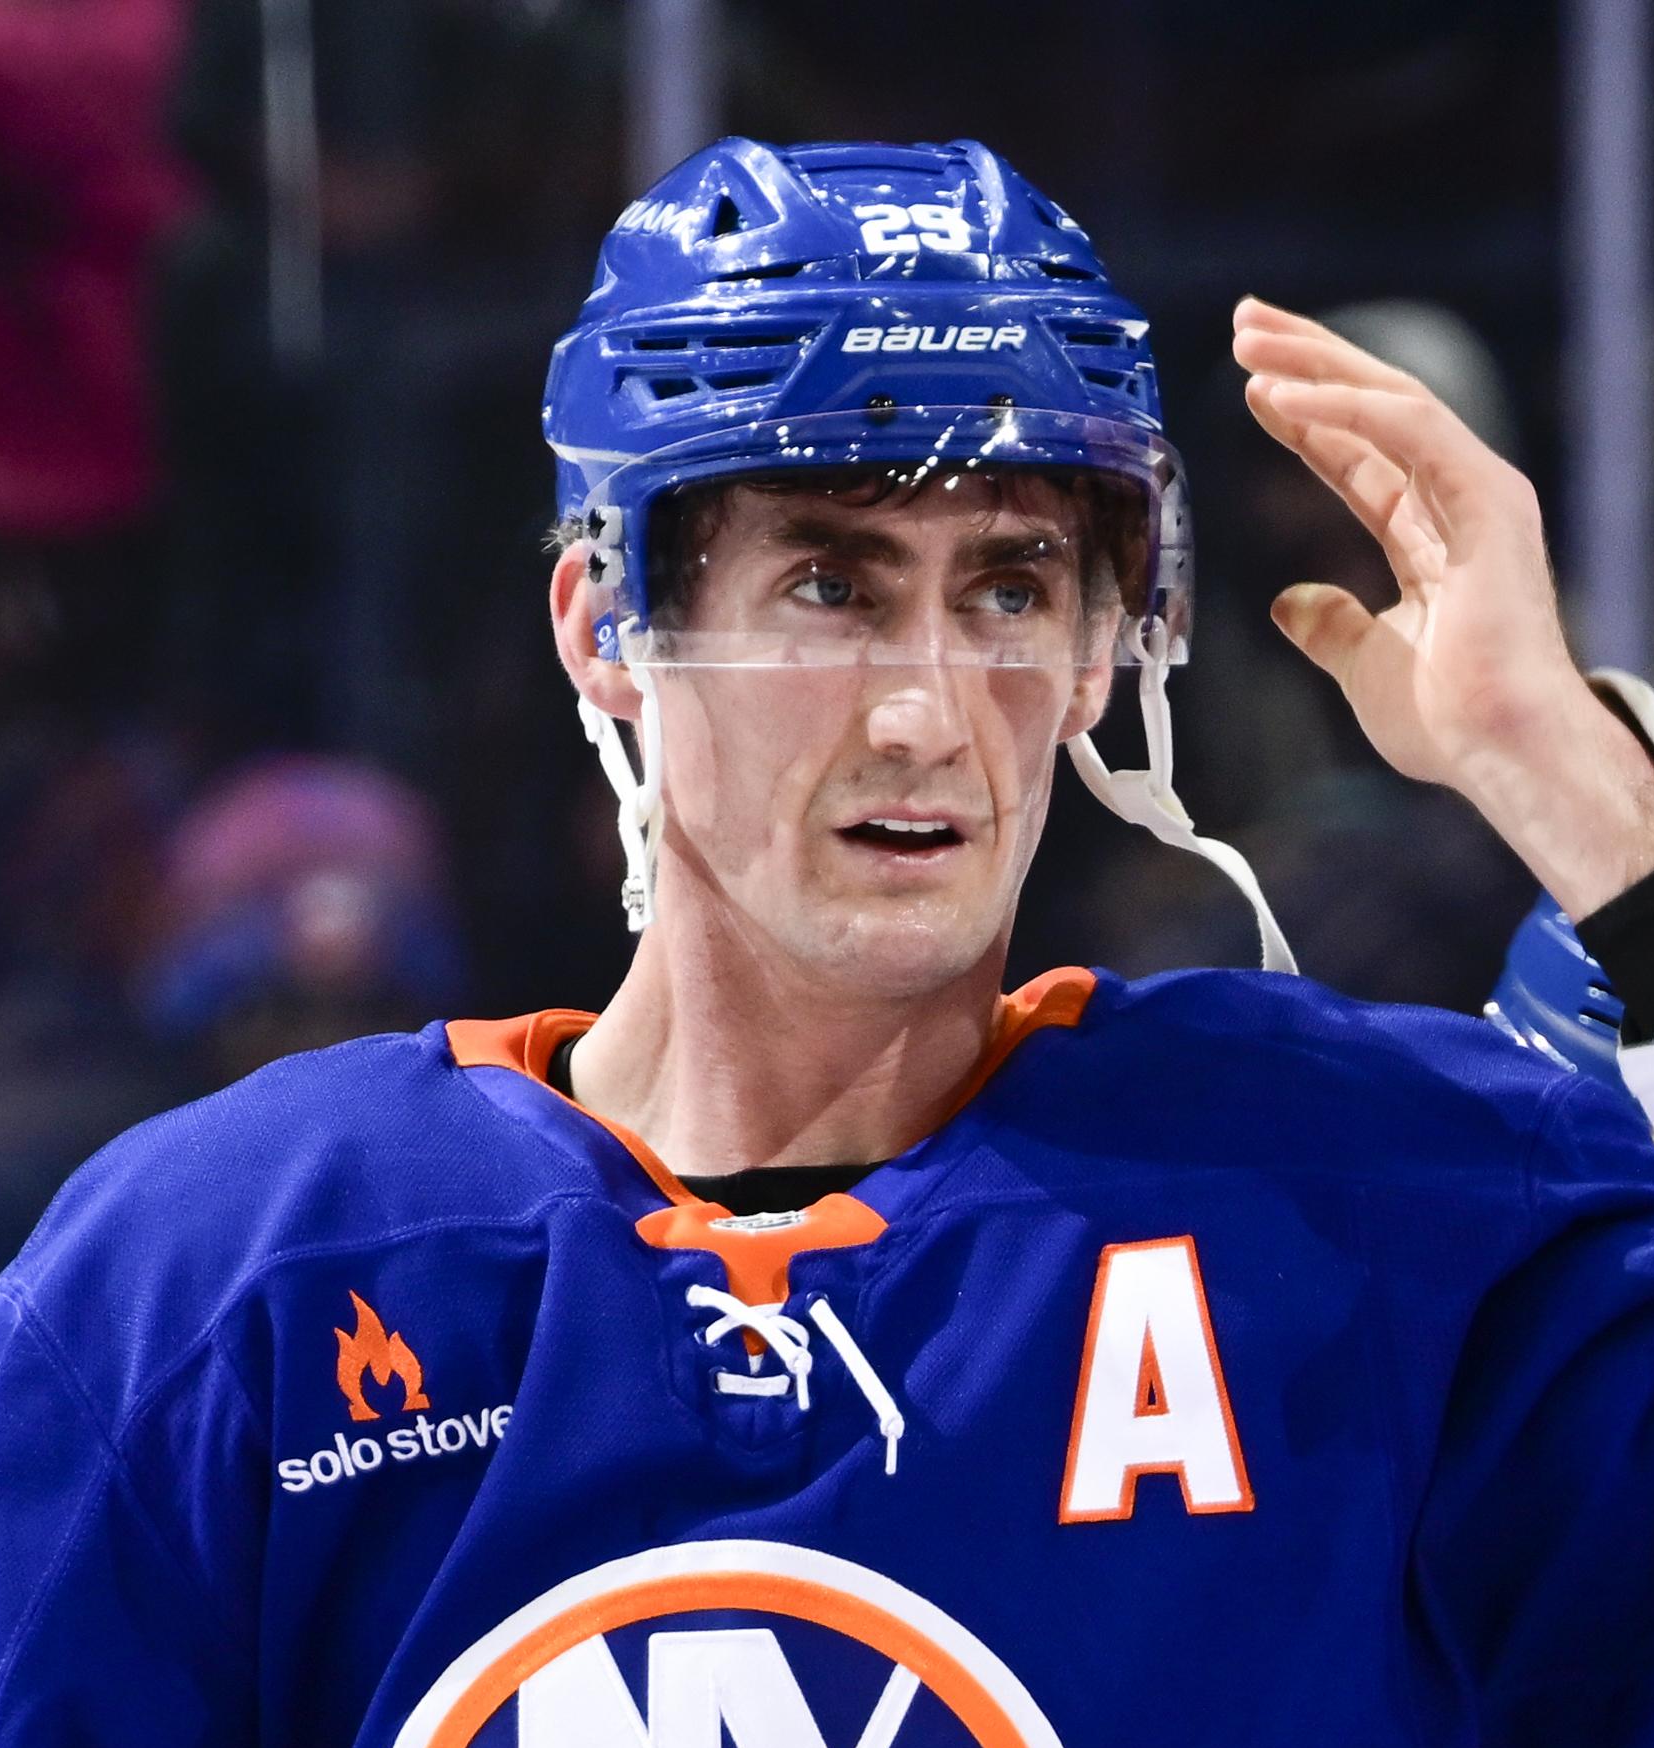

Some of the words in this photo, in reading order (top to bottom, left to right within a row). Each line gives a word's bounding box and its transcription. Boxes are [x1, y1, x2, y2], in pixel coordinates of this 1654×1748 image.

[853, 203, 972, 255] 29
[1058, 1234, 1255, 1525] A
[278, 1433, 383, 1492] solo
[387, 1405, 514, 1460] stove
